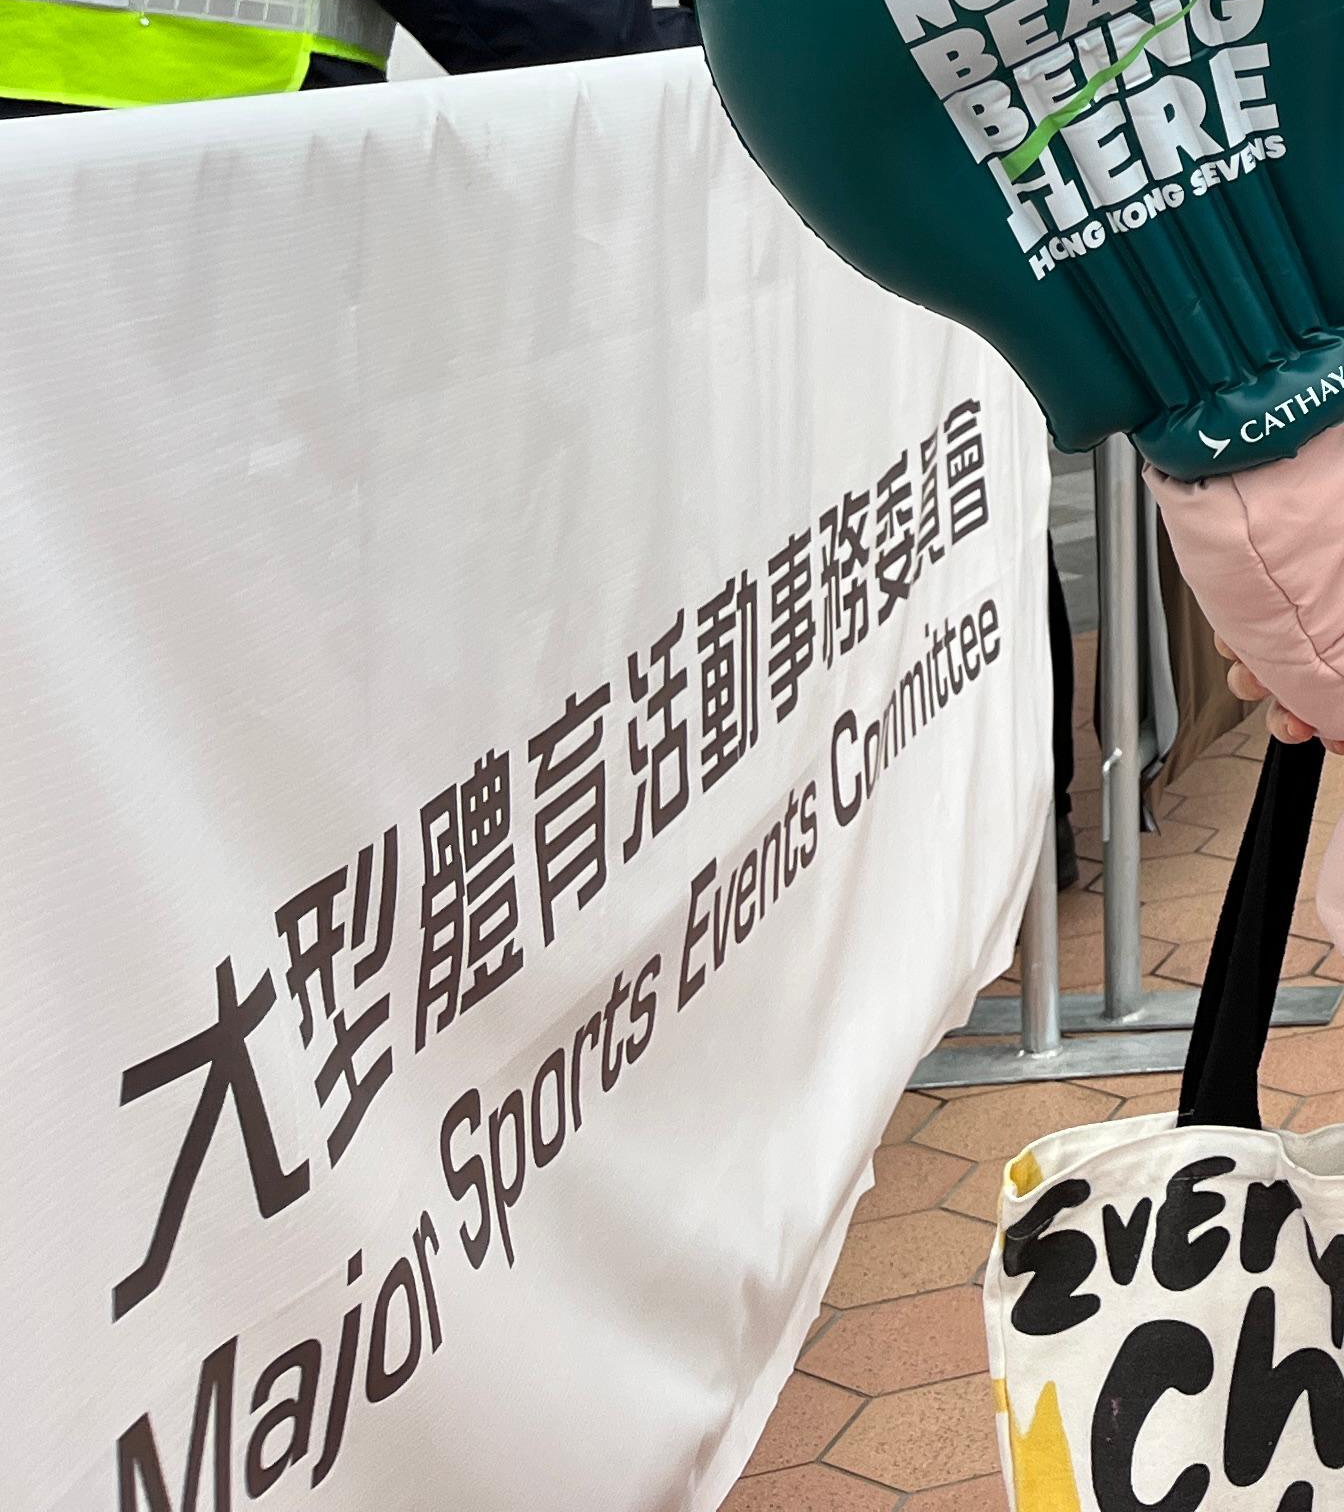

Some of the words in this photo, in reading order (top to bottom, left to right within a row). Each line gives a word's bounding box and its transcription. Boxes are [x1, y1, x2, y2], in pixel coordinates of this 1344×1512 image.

[1000, 41, 1280, 254] HERE
[1028, 217, 1107, 281] HONG
[1108, 182, 1185, 236] KONG
[1189, 134, 1287, 199] SEVENS
[113, 398, 990, 1322] 大型體育活動事務委員會
[115, 1206, 442, 1512] Major
[437, 954, 664, 1270] Sports
[678, 782, 819, 1016] Events
[830, 597, 1003, 827] Committee
